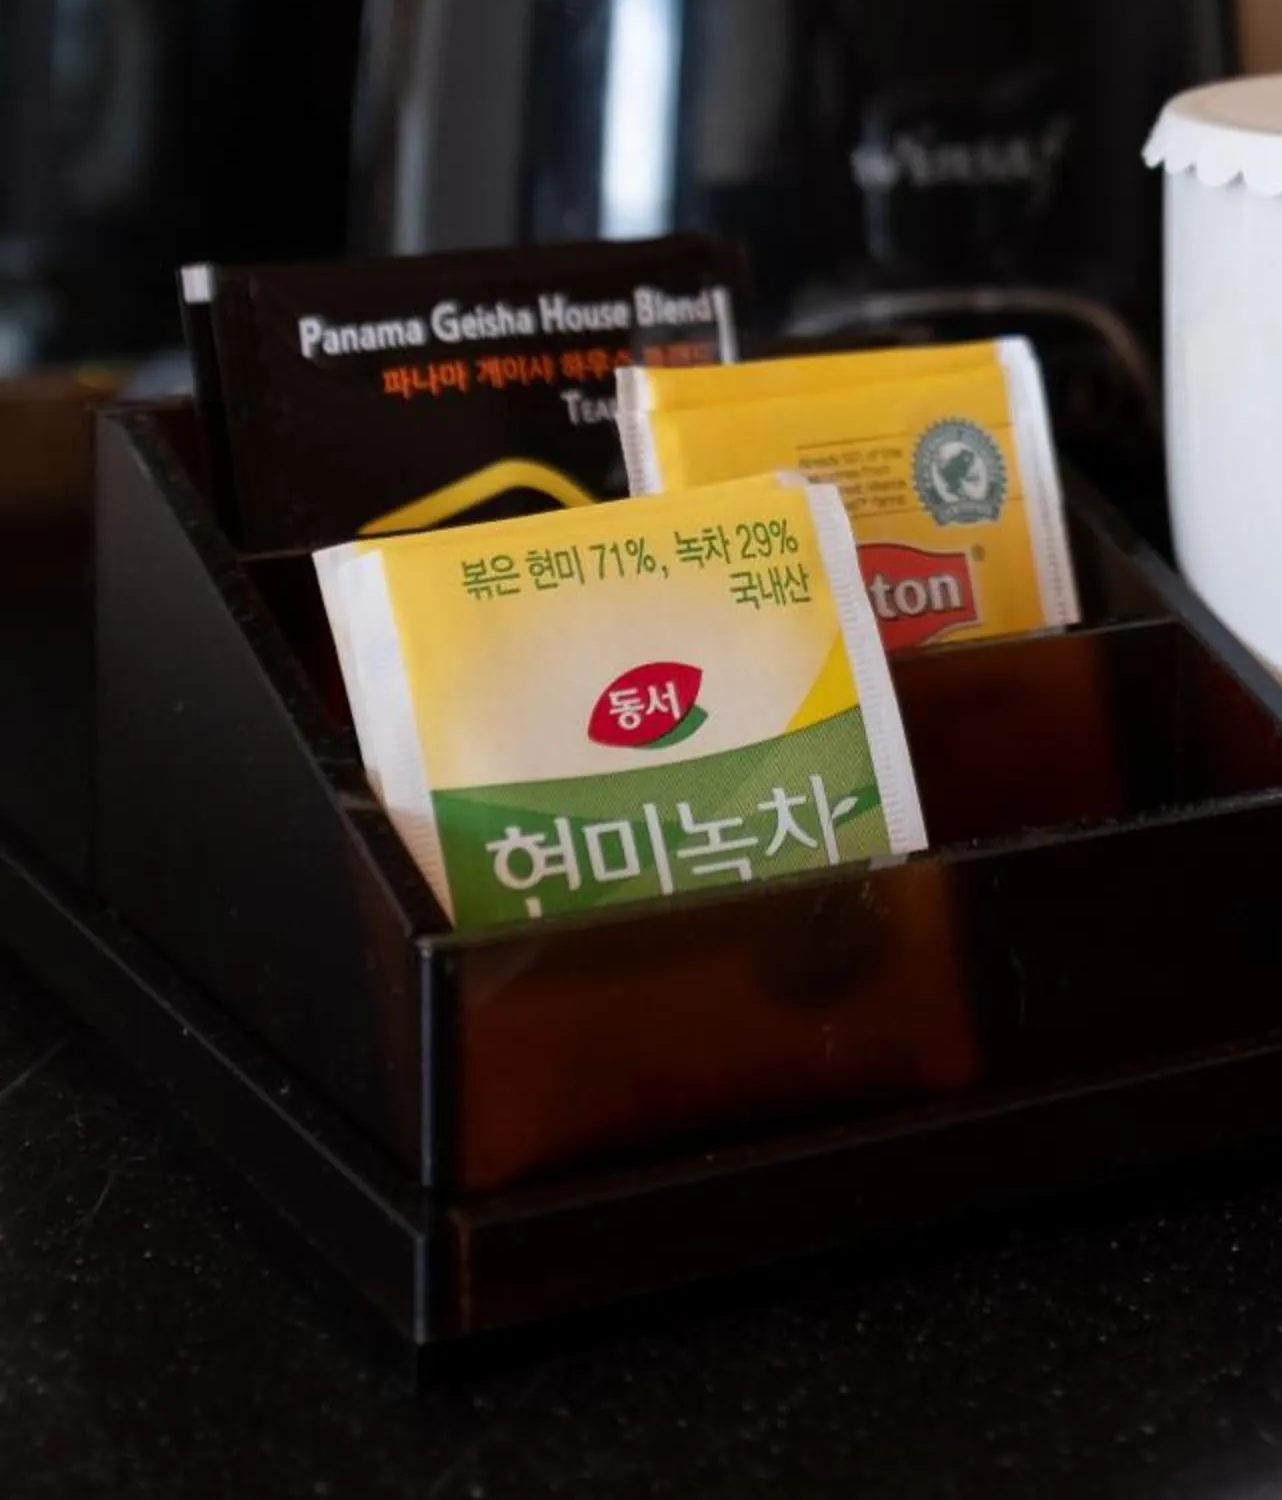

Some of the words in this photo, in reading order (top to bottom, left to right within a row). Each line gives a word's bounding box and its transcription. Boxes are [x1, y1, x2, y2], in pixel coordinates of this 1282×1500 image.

[297, 316, 427, 359] Panama
[430, 301, 534, 343] Geisha
[538, 293, 631, 332] House
[633, 286, 714, 327] Blend
[382, 359, 469, 399] 파나마
[461, 554, 521, 600] 볶은
[525, 545, 586, 591] 현미
[674, 525, 731, 568] 녹차
[735, 518, 799, 560] 29%
[730, 563, 812, 610] 국내산
[868, 569, 963, 619] ton
[608, 679, 683, 731] 동서
[486, 775, 857, 919] 현미녹차
